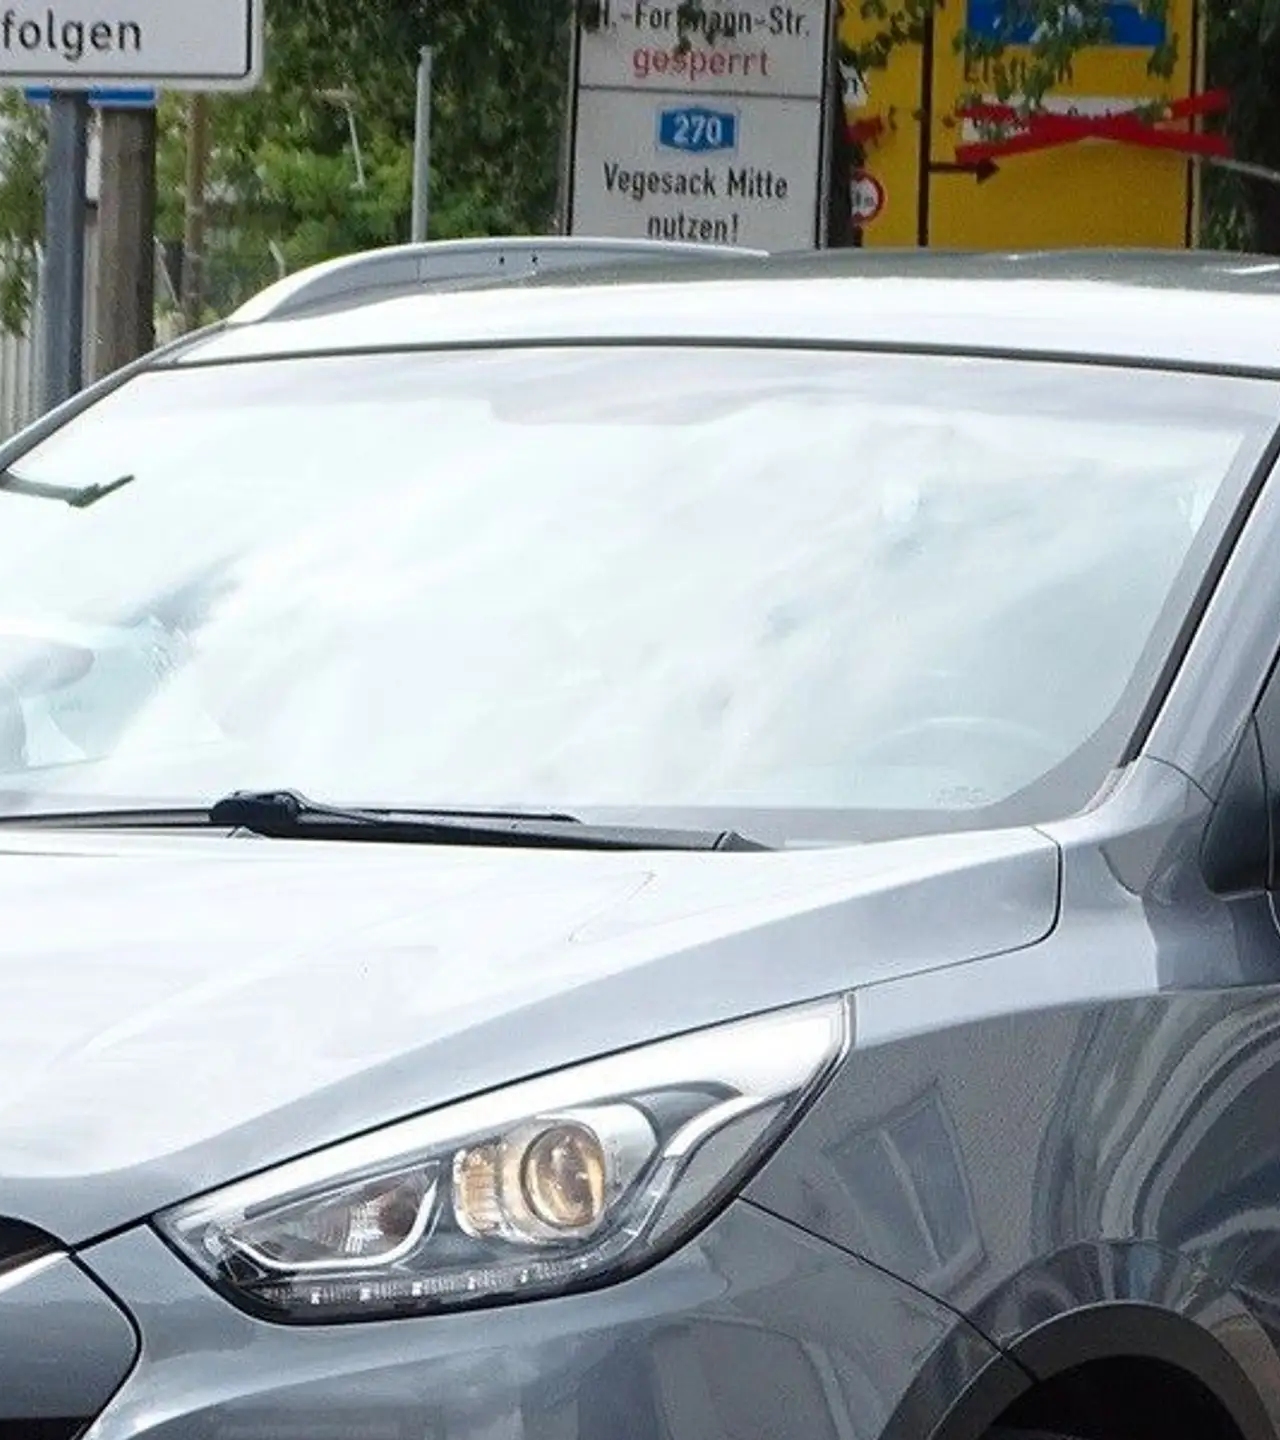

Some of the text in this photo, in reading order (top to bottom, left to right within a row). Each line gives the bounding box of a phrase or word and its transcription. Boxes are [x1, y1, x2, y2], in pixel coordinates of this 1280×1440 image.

[2, 9, 142, 62] folgen
[632, 47, 769, 82] gesperrt
[673, 113, 722, 146] 270
[604, 161, 789, 202] Vegesack Mitte
[647, 212, 739, 244] nutzen!
